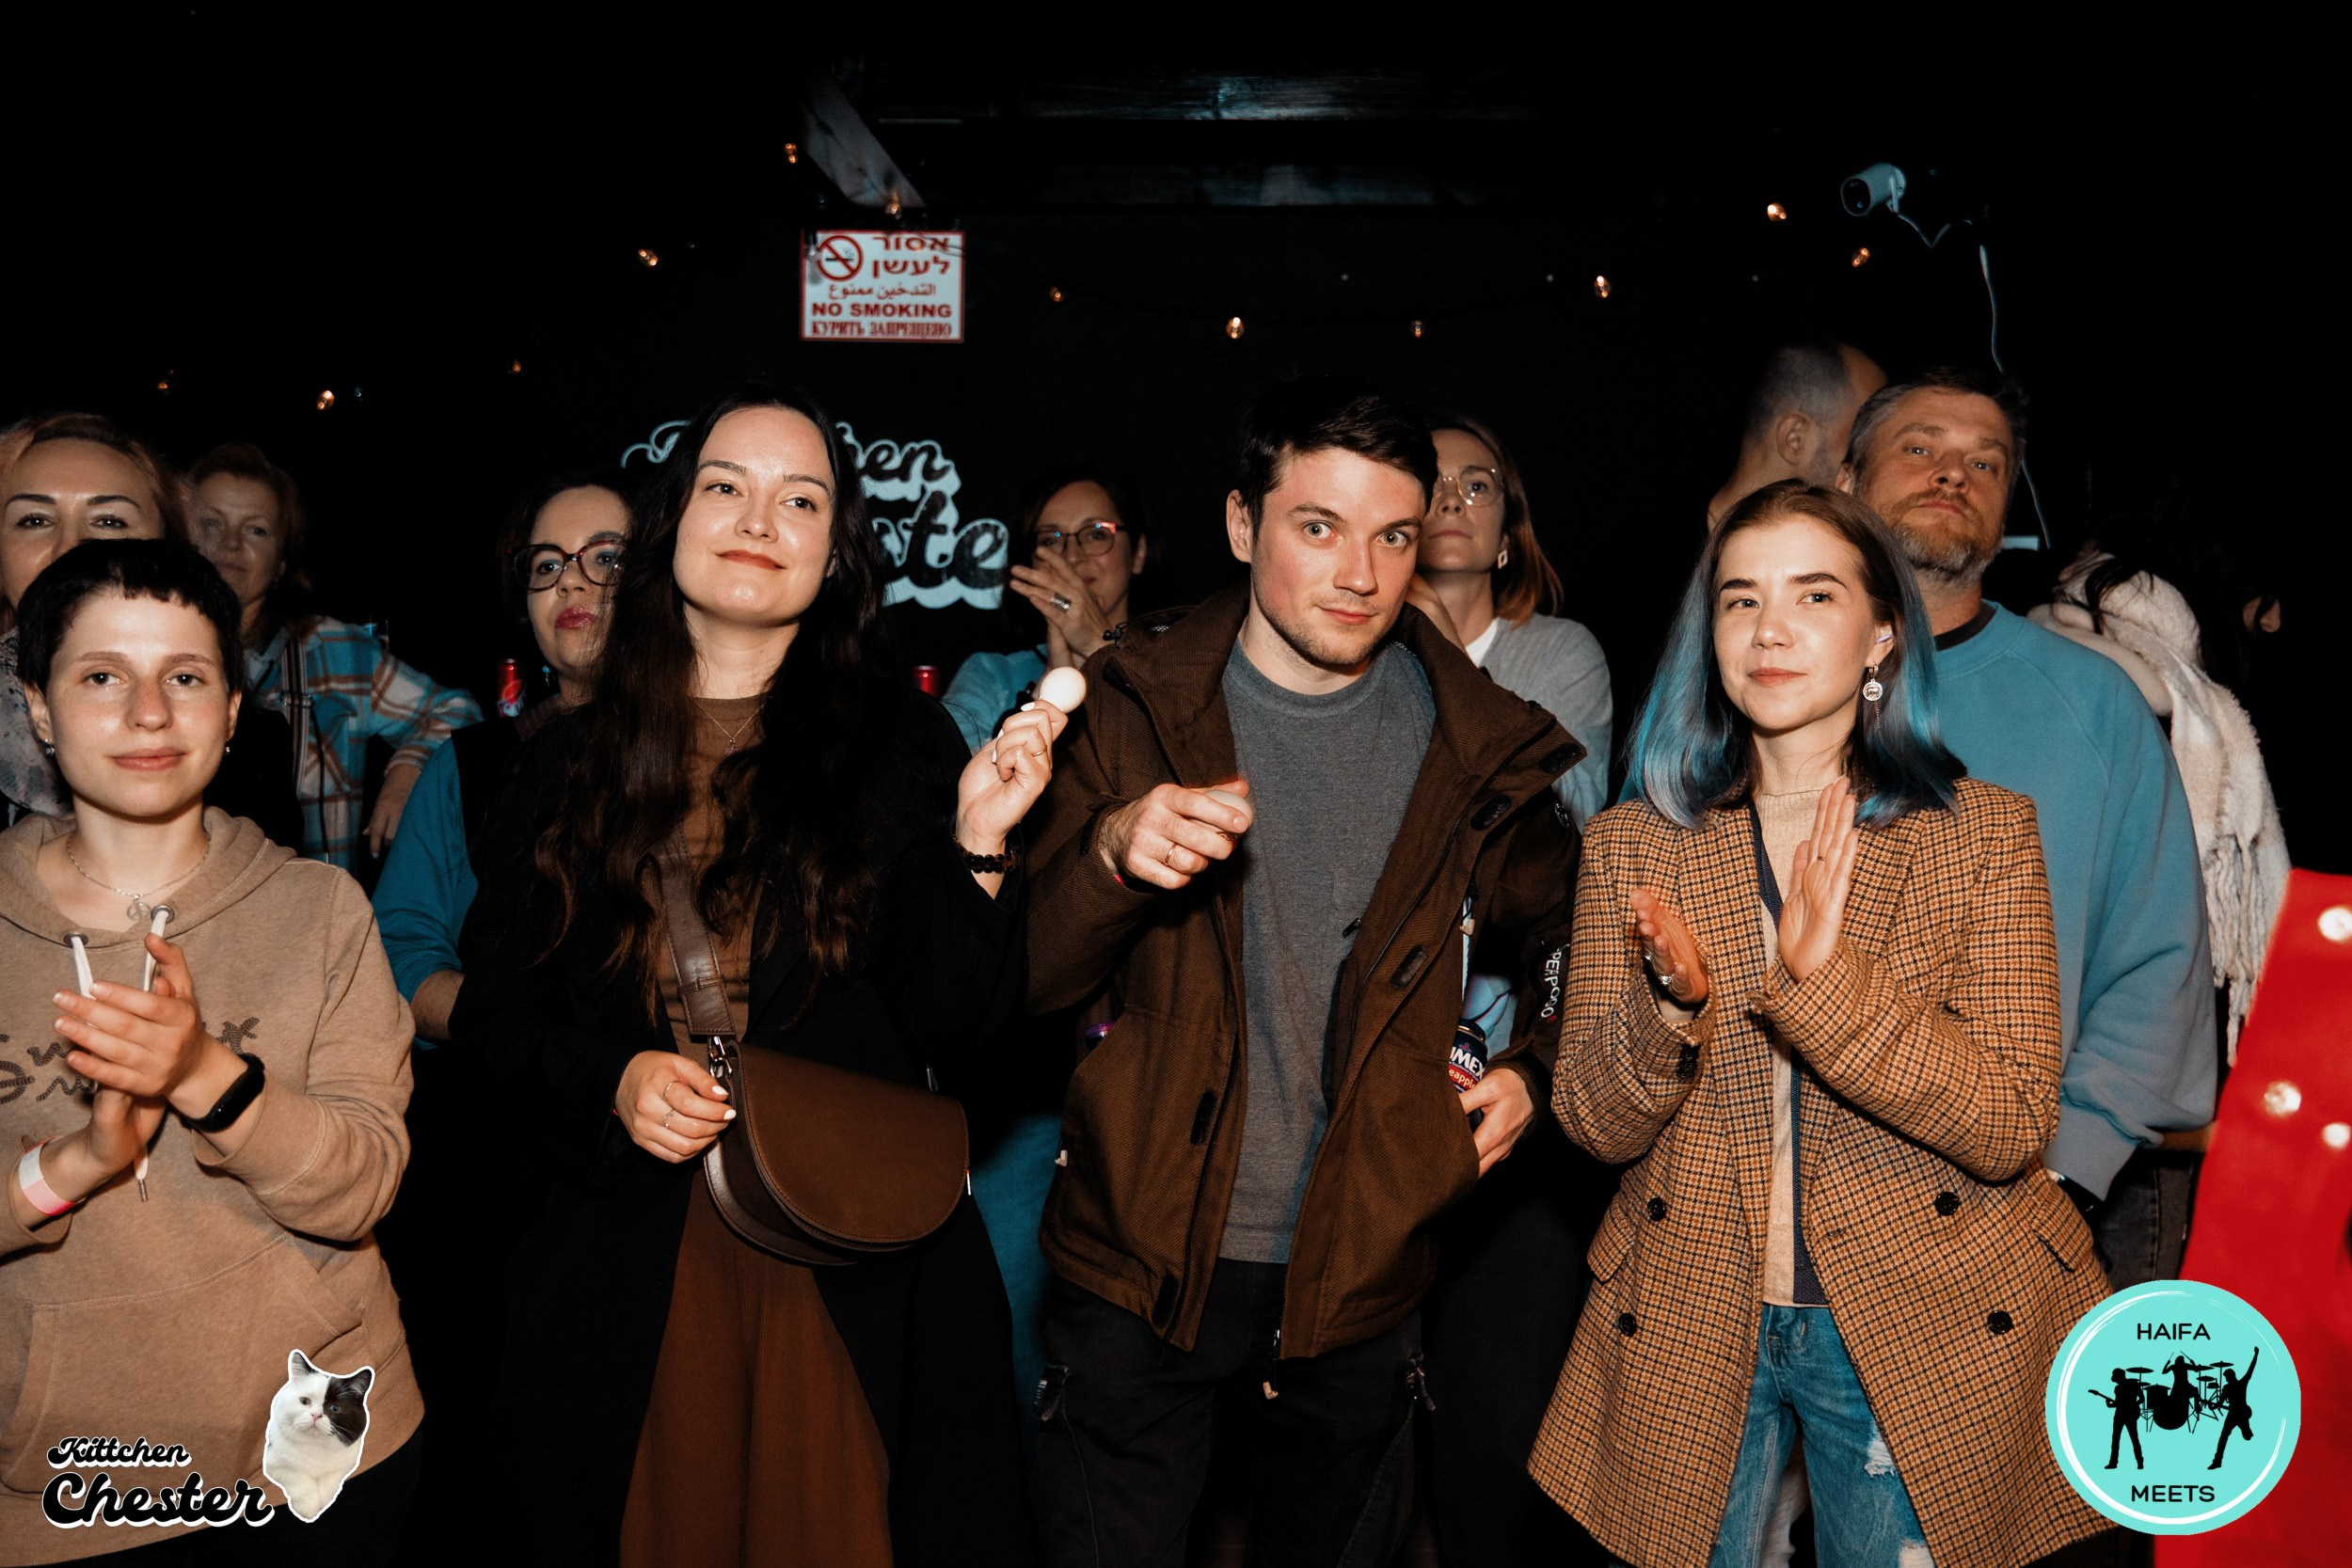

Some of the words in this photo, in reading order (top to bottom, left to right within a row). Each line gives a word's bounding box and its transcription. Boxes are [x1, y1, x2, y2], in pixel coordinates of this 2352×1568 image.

[873, 236, 950, 252] אסור
[872, 256, 950, 279] לעשן
[828, 283, 874, 300] ممنوع
[812, 303, 843, 316] NO
[850, 303, 952, 318] SMOKING
[812, 321, 865, 336] КУРИТЬ
[870, 322, 952, 338] ЗАПРЕЩЕНО
